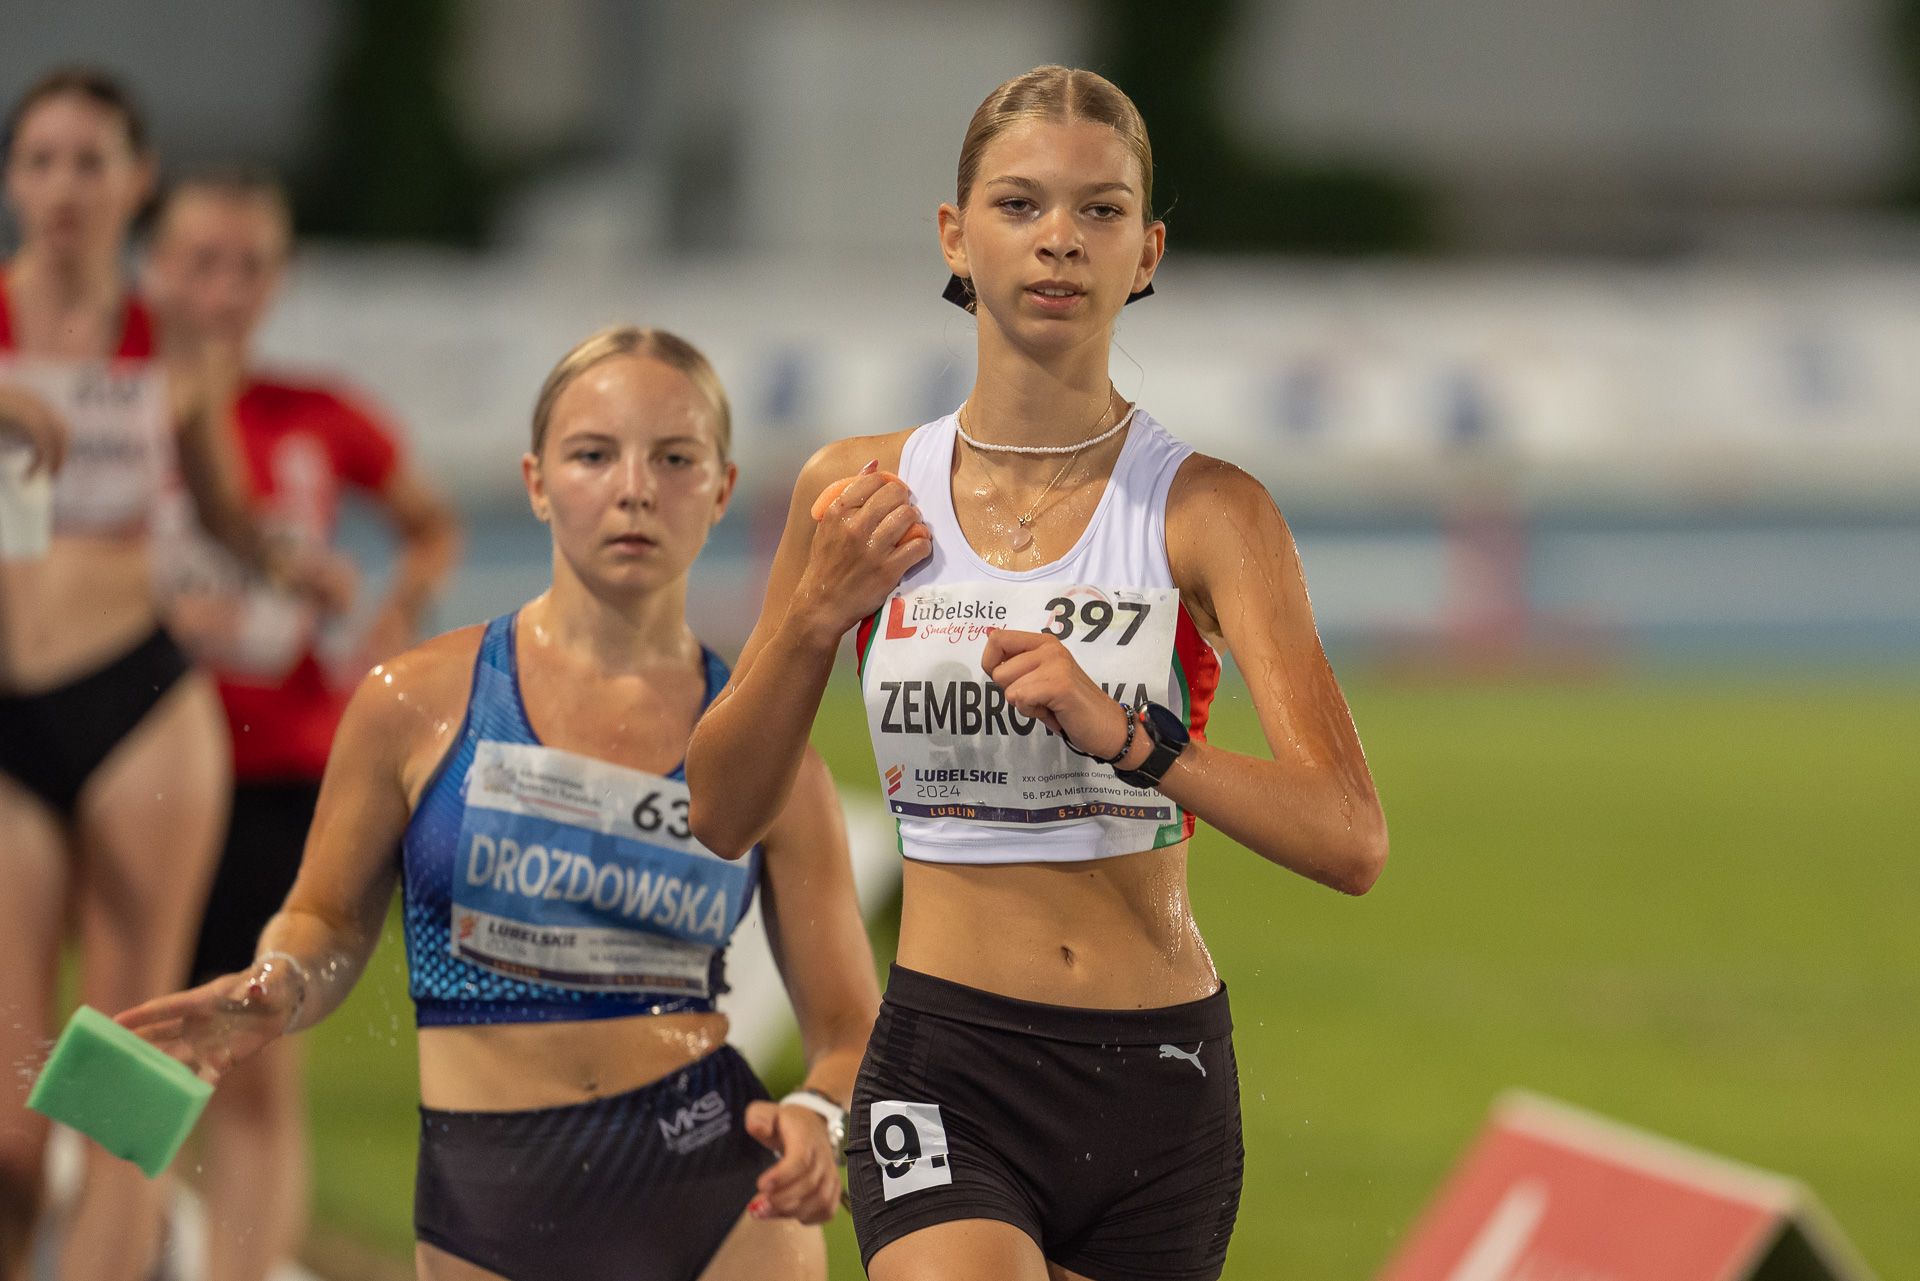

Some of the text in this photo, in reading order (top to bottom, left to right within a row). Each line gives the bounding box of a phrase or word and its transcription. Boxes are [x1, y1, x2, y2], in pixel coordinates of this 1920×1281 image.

[912, 601, 1007, 620] lubelskie
[1041, 597, 1151, 646] 397
[921, 622, 968, 644] Smakuj
[915, 769, 1008, 785] LUBELSKIE
[1022, 775, 1036, 783] XXX
[1037, 771, 1090, 784] Ogólnopolska
[916, 785, 961, 798] 2024
[1022, 791, 1038, 800] 56.
[1039, 789, 1063, 799] PZLA
[1064, 786, 1121, 796] Mistrzostwa
[1123, 789, 1151, 798] Polski
[930, 806, 975, 818] LUBLIN
[1058, 804, 1145, 819] 5-7.07.2024
[467, 834, 728, 940] DROZDOWSKA
[873, 1113, 946, 1179] 9.
